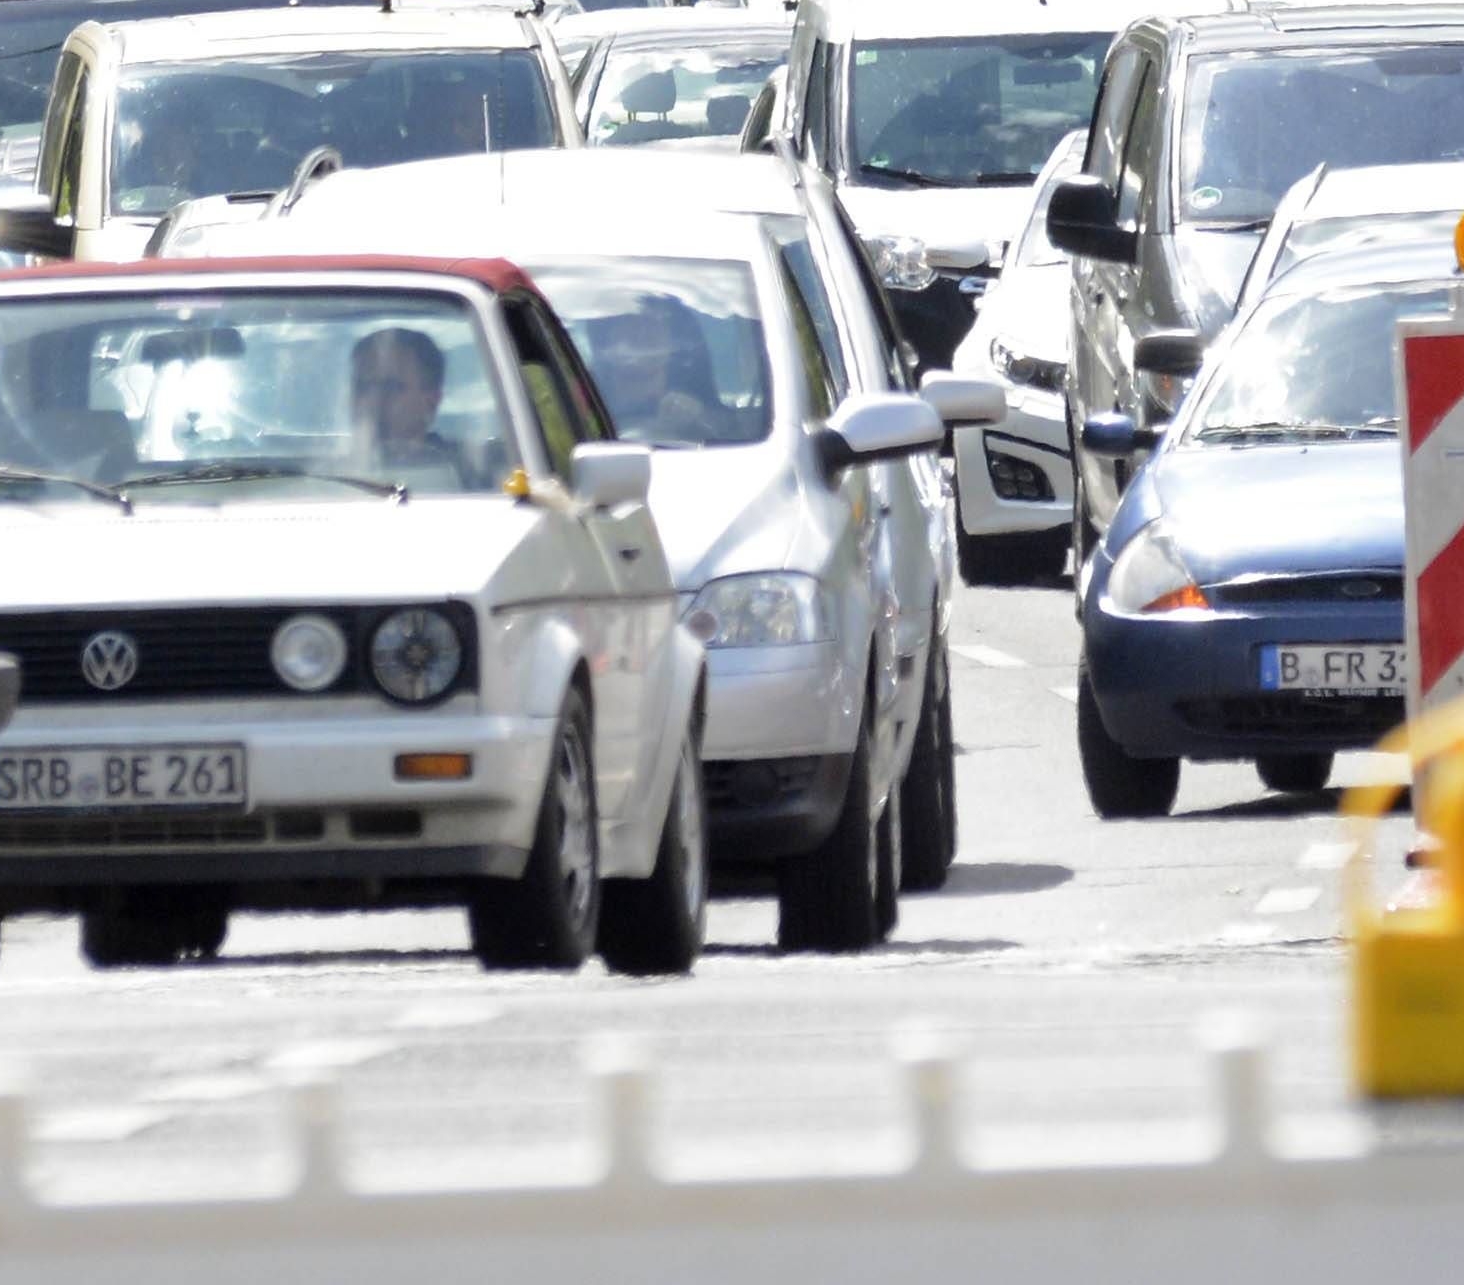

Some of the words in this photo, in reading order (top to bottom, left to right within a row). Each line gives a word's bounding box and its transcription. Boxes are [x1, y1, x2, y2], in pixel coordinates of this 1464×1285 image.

[1280, 652, 1300, 683] B
[1324, 652, 1366, 683] FR
[103, 756, 153, 798] BE
[165, 754, 238, 798] 261
